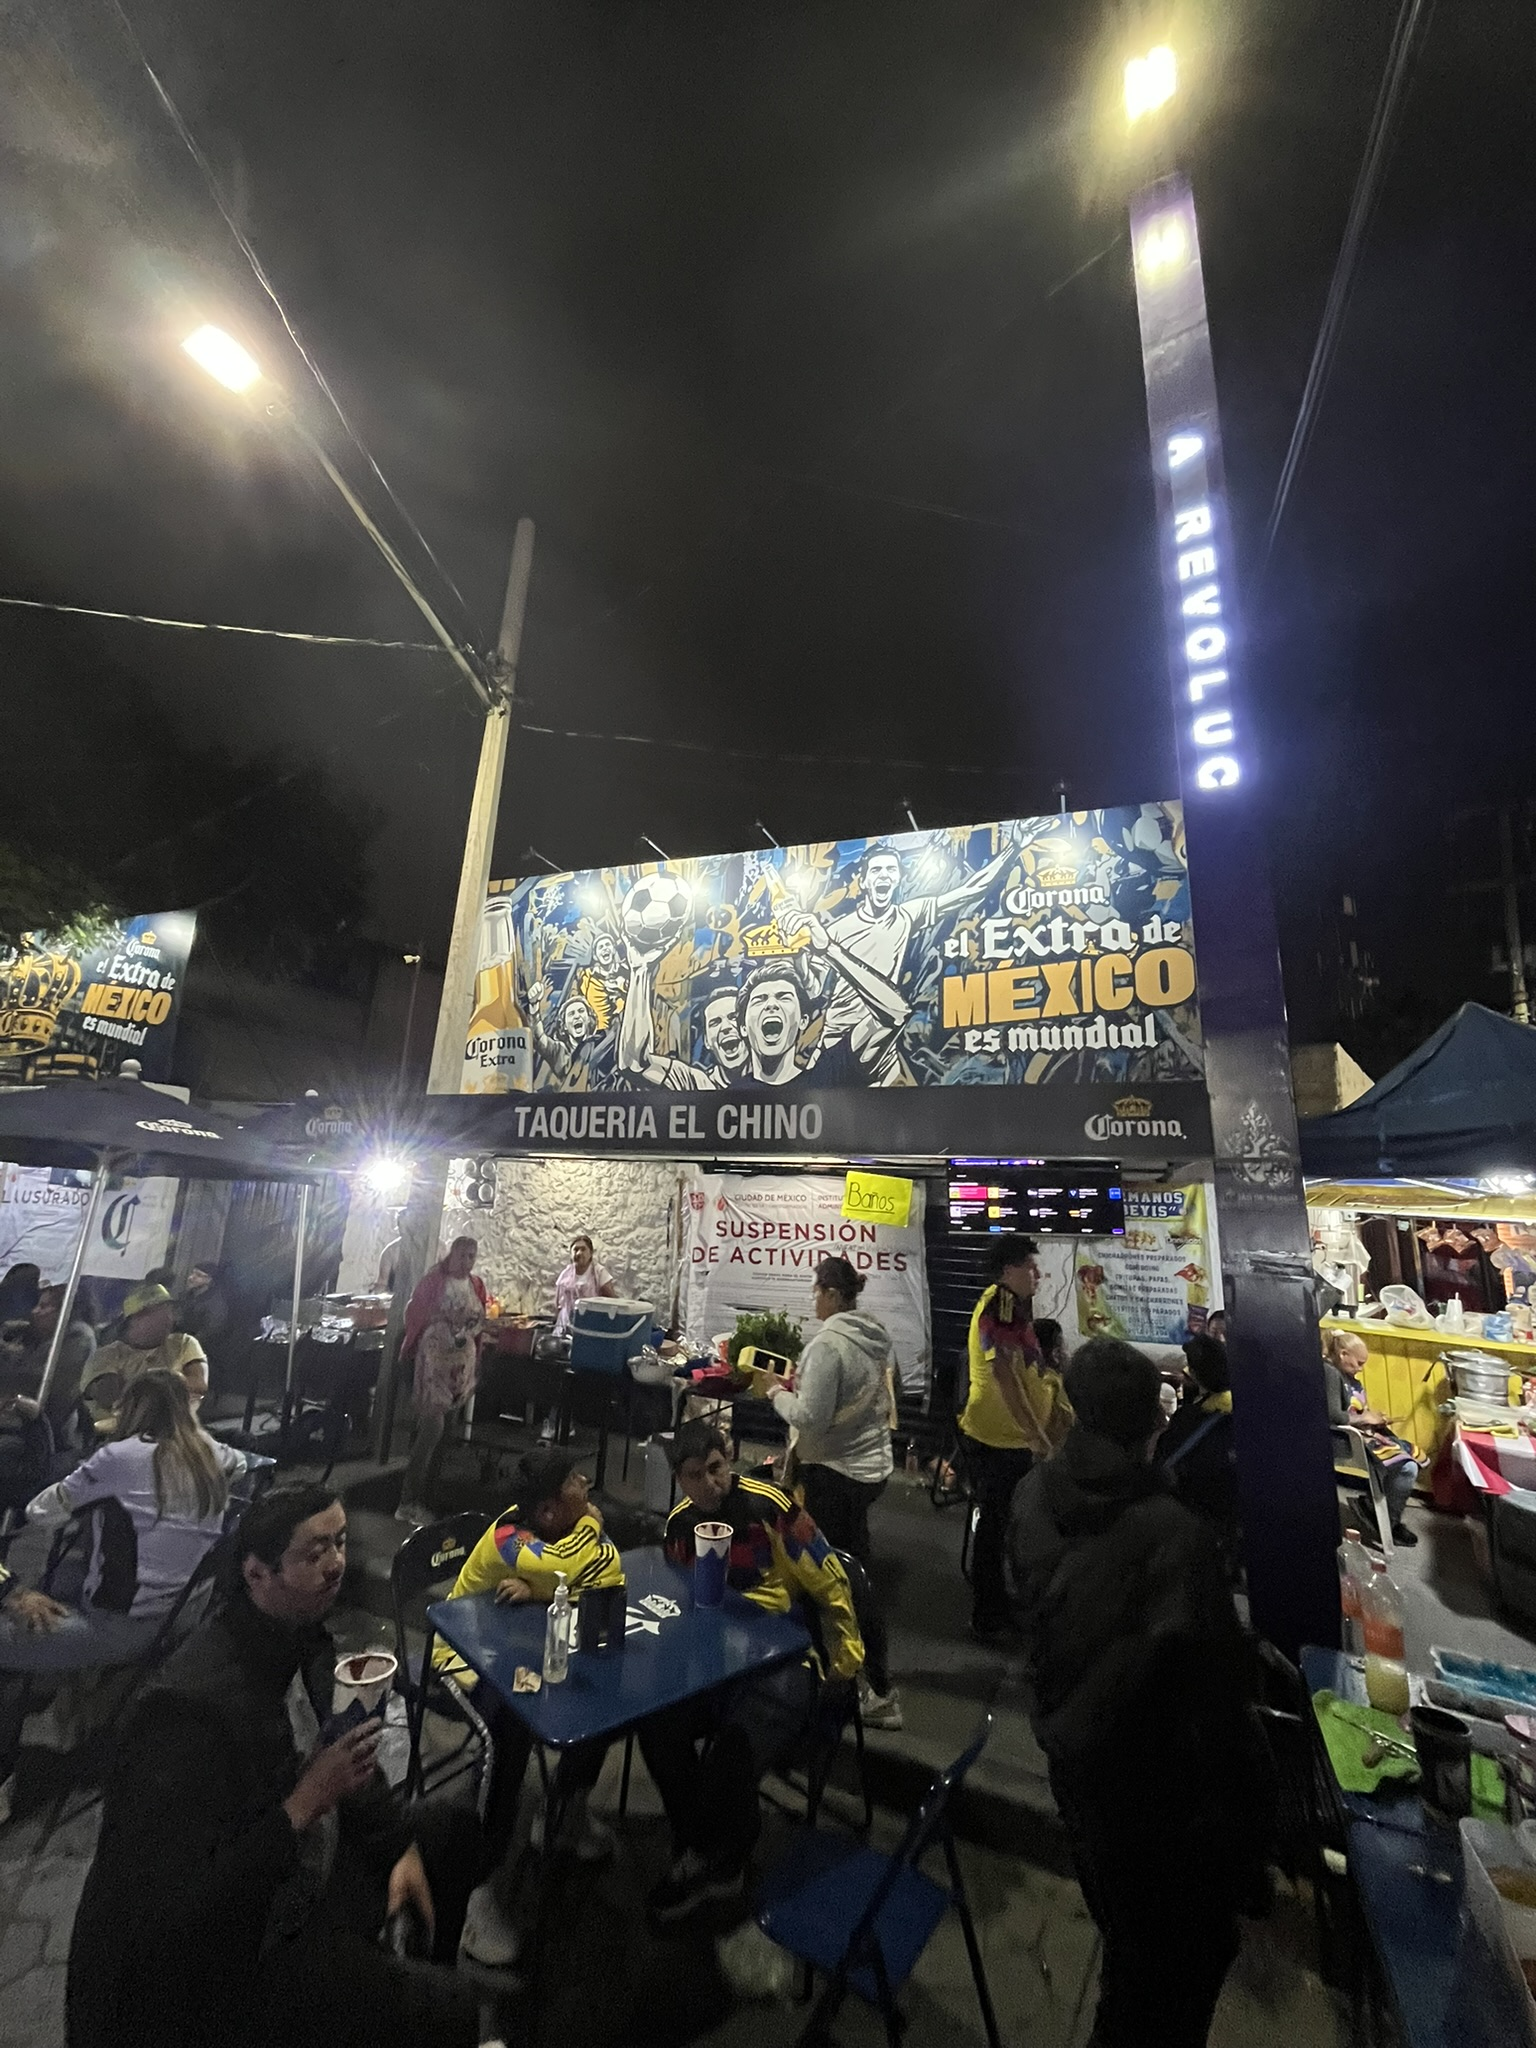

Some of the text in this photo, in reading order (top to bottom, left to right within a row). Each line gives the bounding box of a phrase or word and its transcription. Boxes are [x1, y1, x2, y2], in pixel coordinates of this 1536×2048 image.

[1005, 884, 1110, 916] Corona
[126, 938, 161, 961] Corona
[943, 915, 1183, 960] el Extra de
[96, 955, 176, 991] el Extra de
[943, 946, 1196, 1029] MÉXICO
[81, 980, 172, 1025] MÉXICO
[83, 1015, 148, 1046] es mundial
[964, 1013, 1159, 1054] es mundial
[465, 1034, 527, 1062] Corona
[480, 1053, 516, 1067] Extra
[136, 1120, 223, 1140] Corona
[305, 1117, 353, 1136] Corona
[515, 1103, 824, 1141] TAQUERIA EL CHINO
[1084, 1113, 1187, 1141] Corona
[764, 1194, 775, 1202] DE
[776, 1193, 807, 1203] MÉXICO
[848, 1181, 895, 1211] Baños
[1123, 1191, 1183, 1204] MANOS
[715, 1219, 877, 1243] SUSPENSIÓN
[692, 1246, 719, 1263] DE
